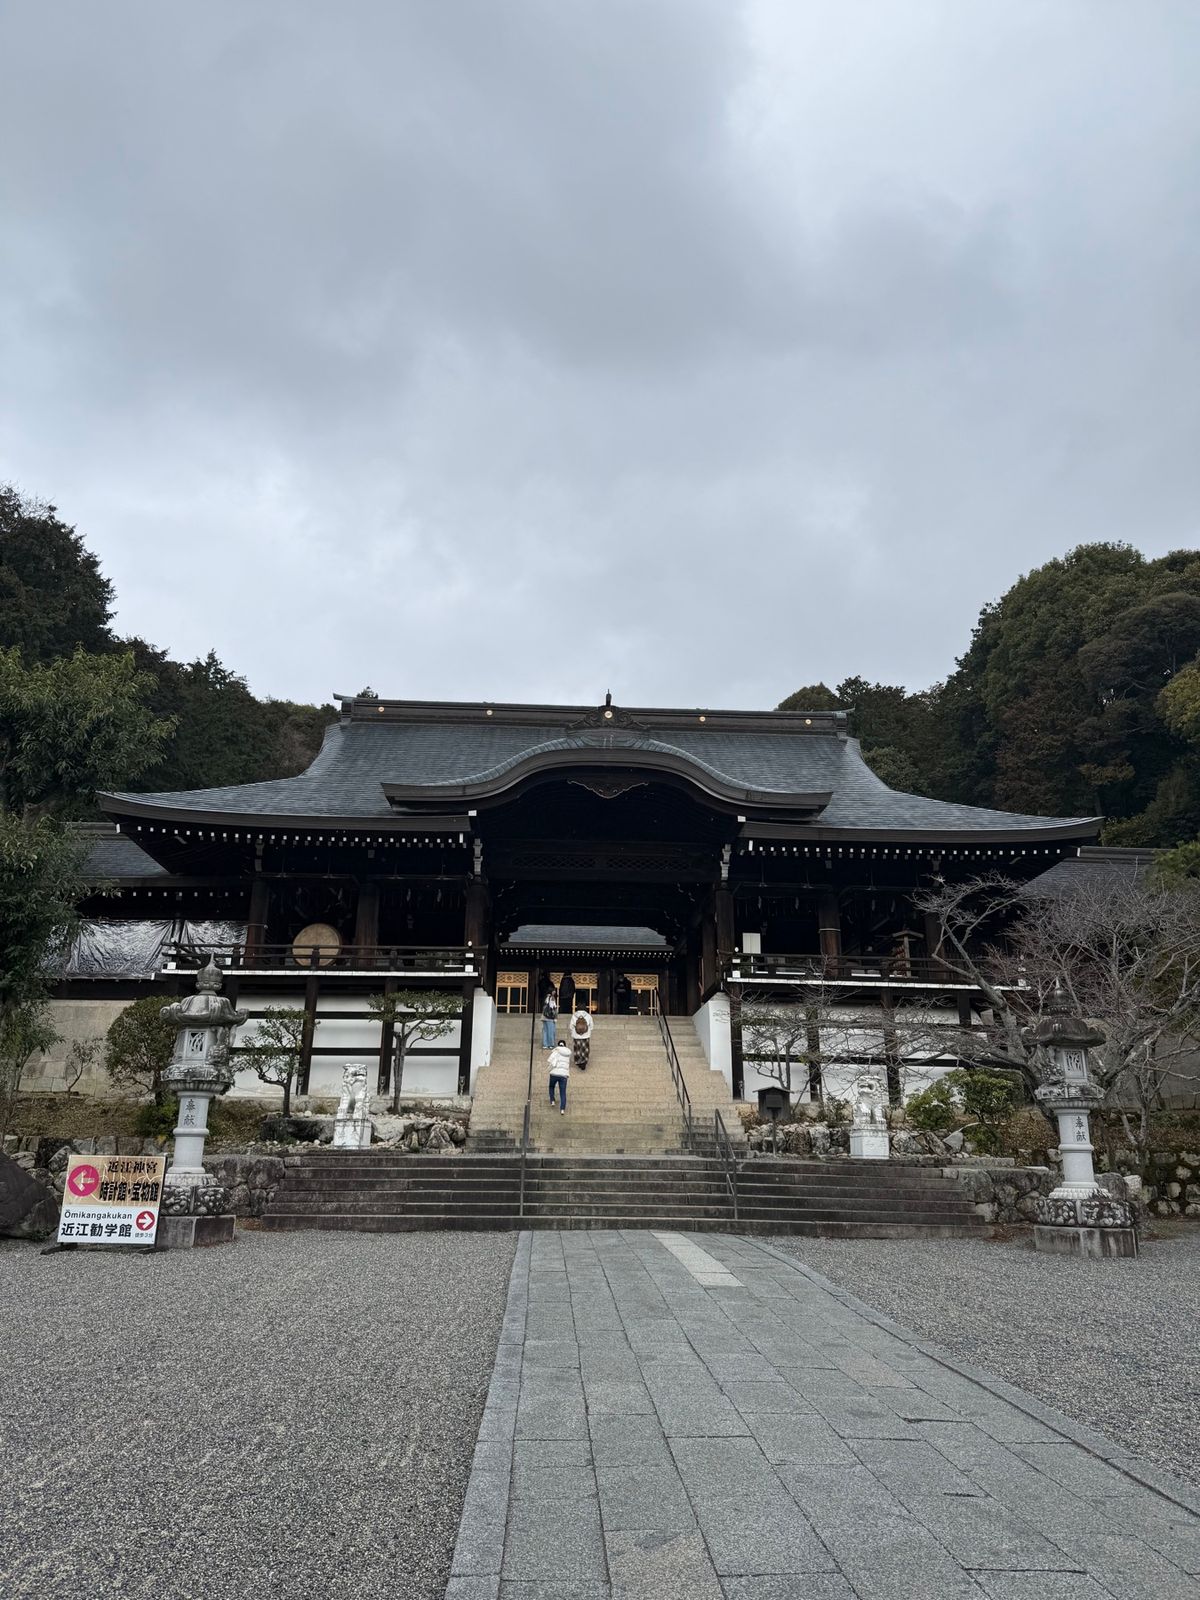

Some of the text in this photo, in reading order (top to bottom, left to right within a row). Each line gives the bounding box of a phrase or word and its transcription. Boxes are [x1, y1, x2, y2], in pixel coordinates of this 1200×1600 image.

[108, 1161, 158, 1173] 近江神宮
[61, 1222, 132, 1238] 近江勧学館
